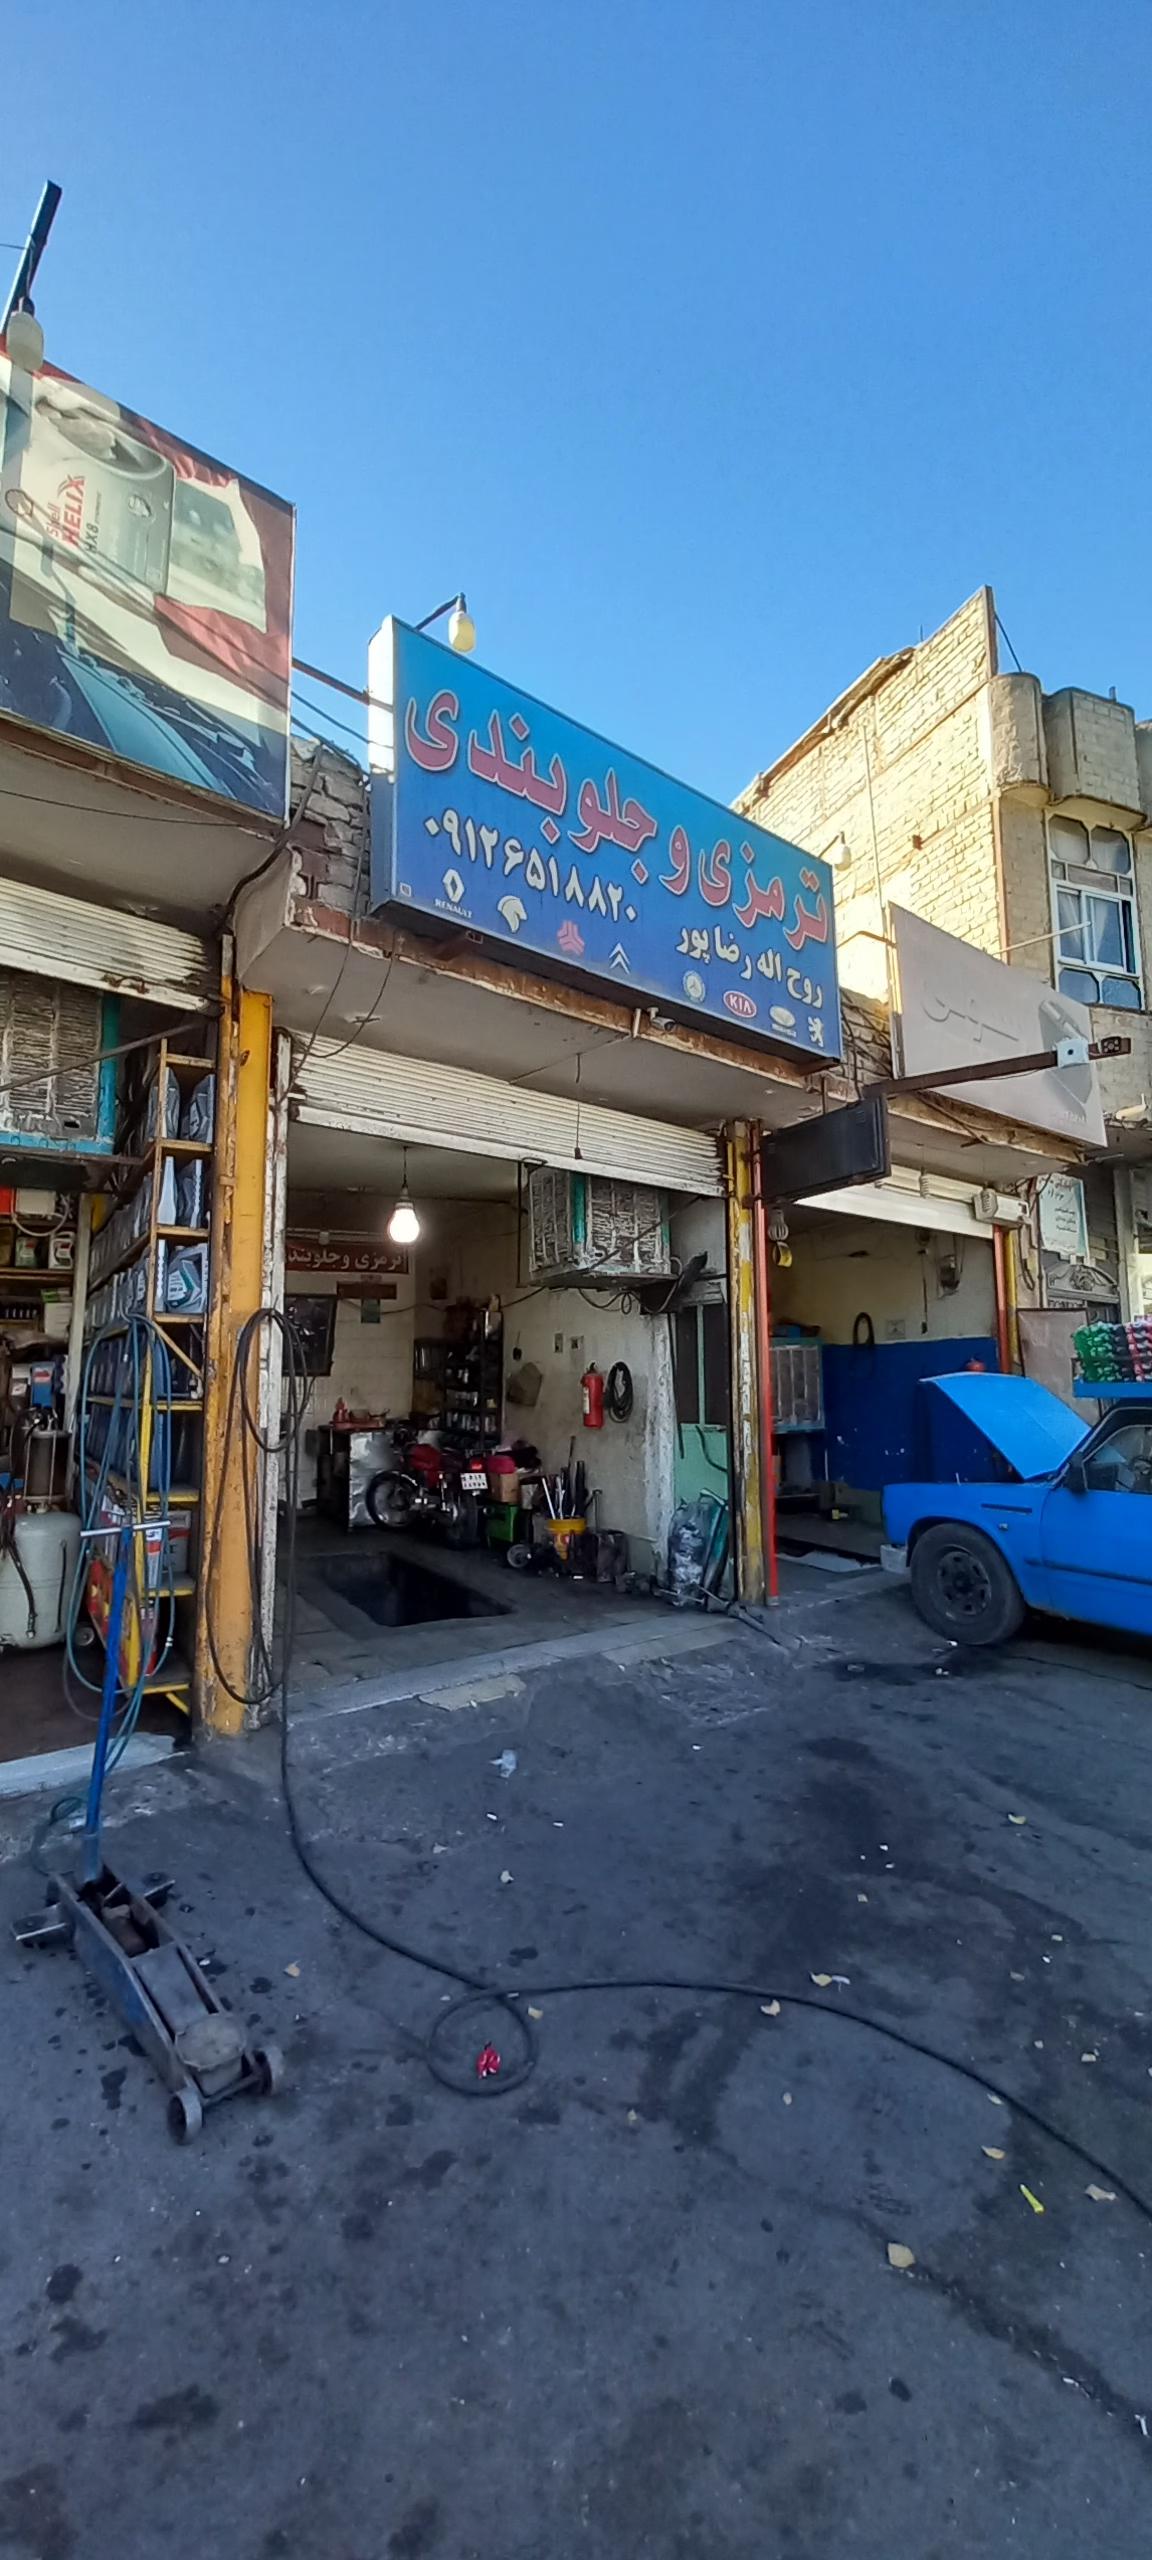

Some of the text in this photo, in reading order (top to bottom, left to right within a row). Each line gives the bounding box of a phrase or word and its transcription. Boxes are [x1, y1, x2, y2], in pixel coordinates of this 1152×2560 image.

[61, 475, 86, 547] HELIX
[83, 522, 99, 553] HX8
[424, 809, 637, 922] ۰۹۱۲۶۵۱۸۸۲۰
[658, 825, 690, 895] و
[434, 898, 473, 919] RENAULT
[698, 839, 828, 951] ترمزی
[757, 949, 782, 982] اله
[727, 992, 752, 1015] KIA
[786, 967, 823, 1009] روح
